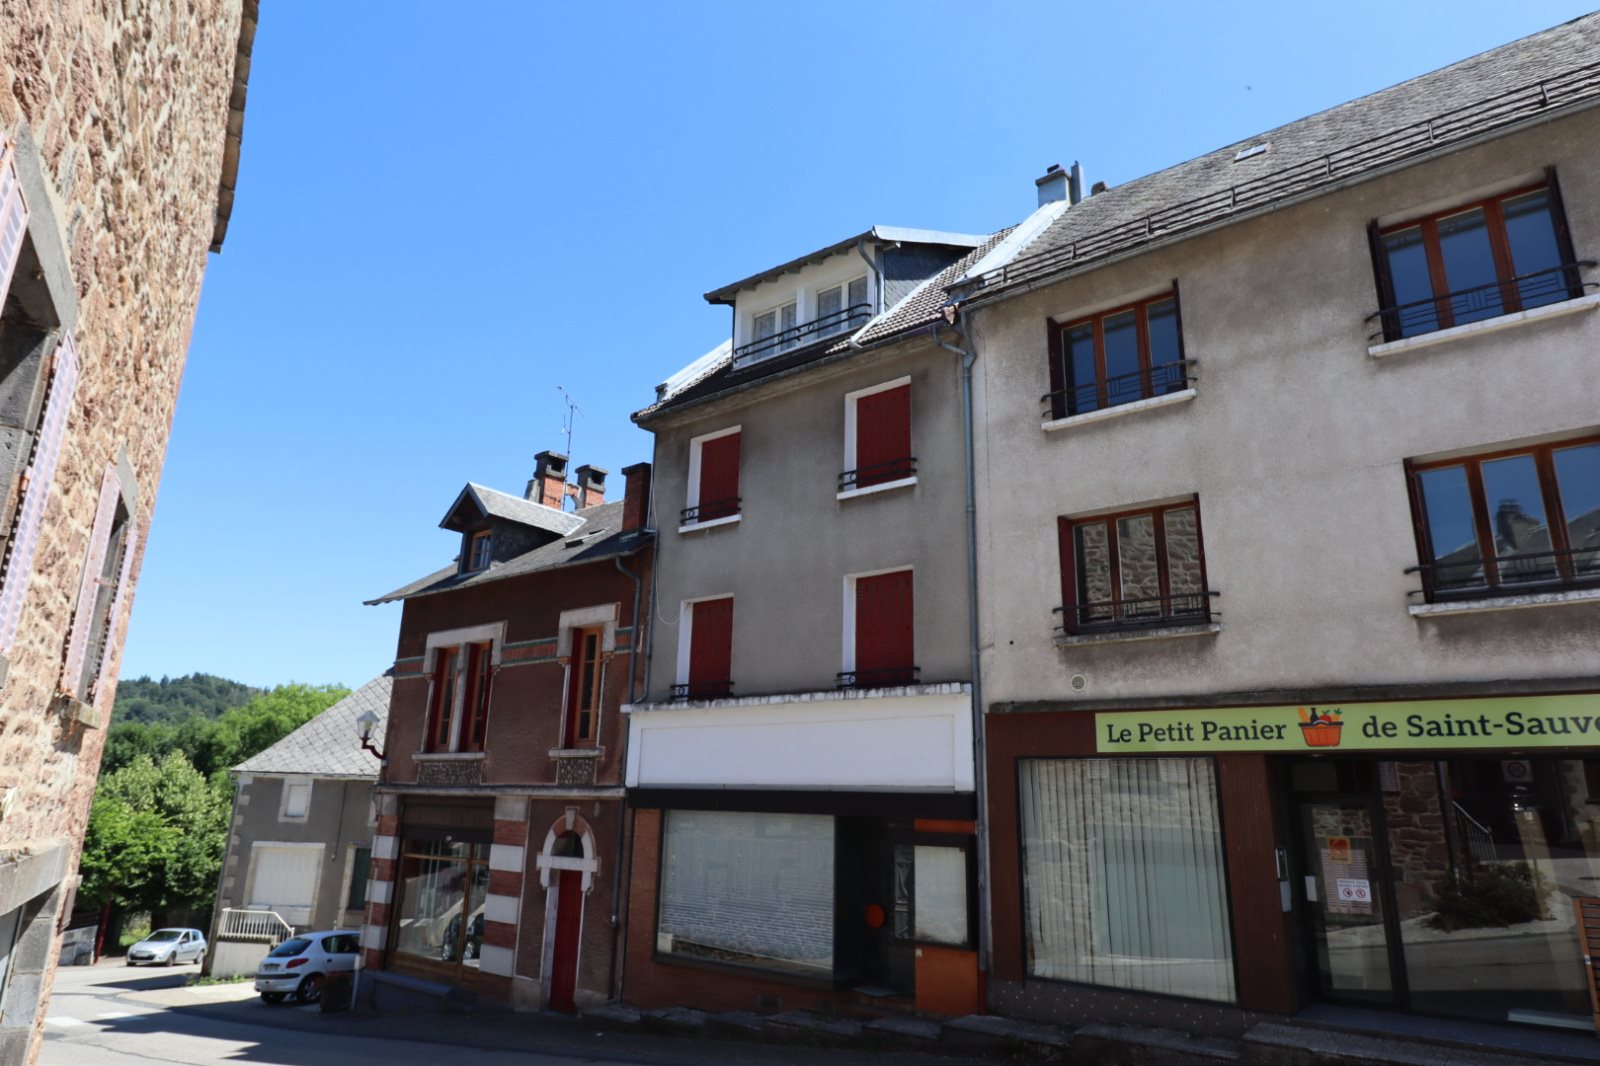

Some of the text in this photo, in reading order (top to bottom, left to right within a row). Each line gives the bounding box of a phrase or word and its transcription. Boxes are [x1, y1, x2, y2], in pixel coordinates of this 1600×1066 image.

[1107, 724, 1131, 743] Le
[1138, 722, 1194, 742] Petit
[1201, 720, 1287, 741] Panier
[1362, 715, 1398, 738] de
